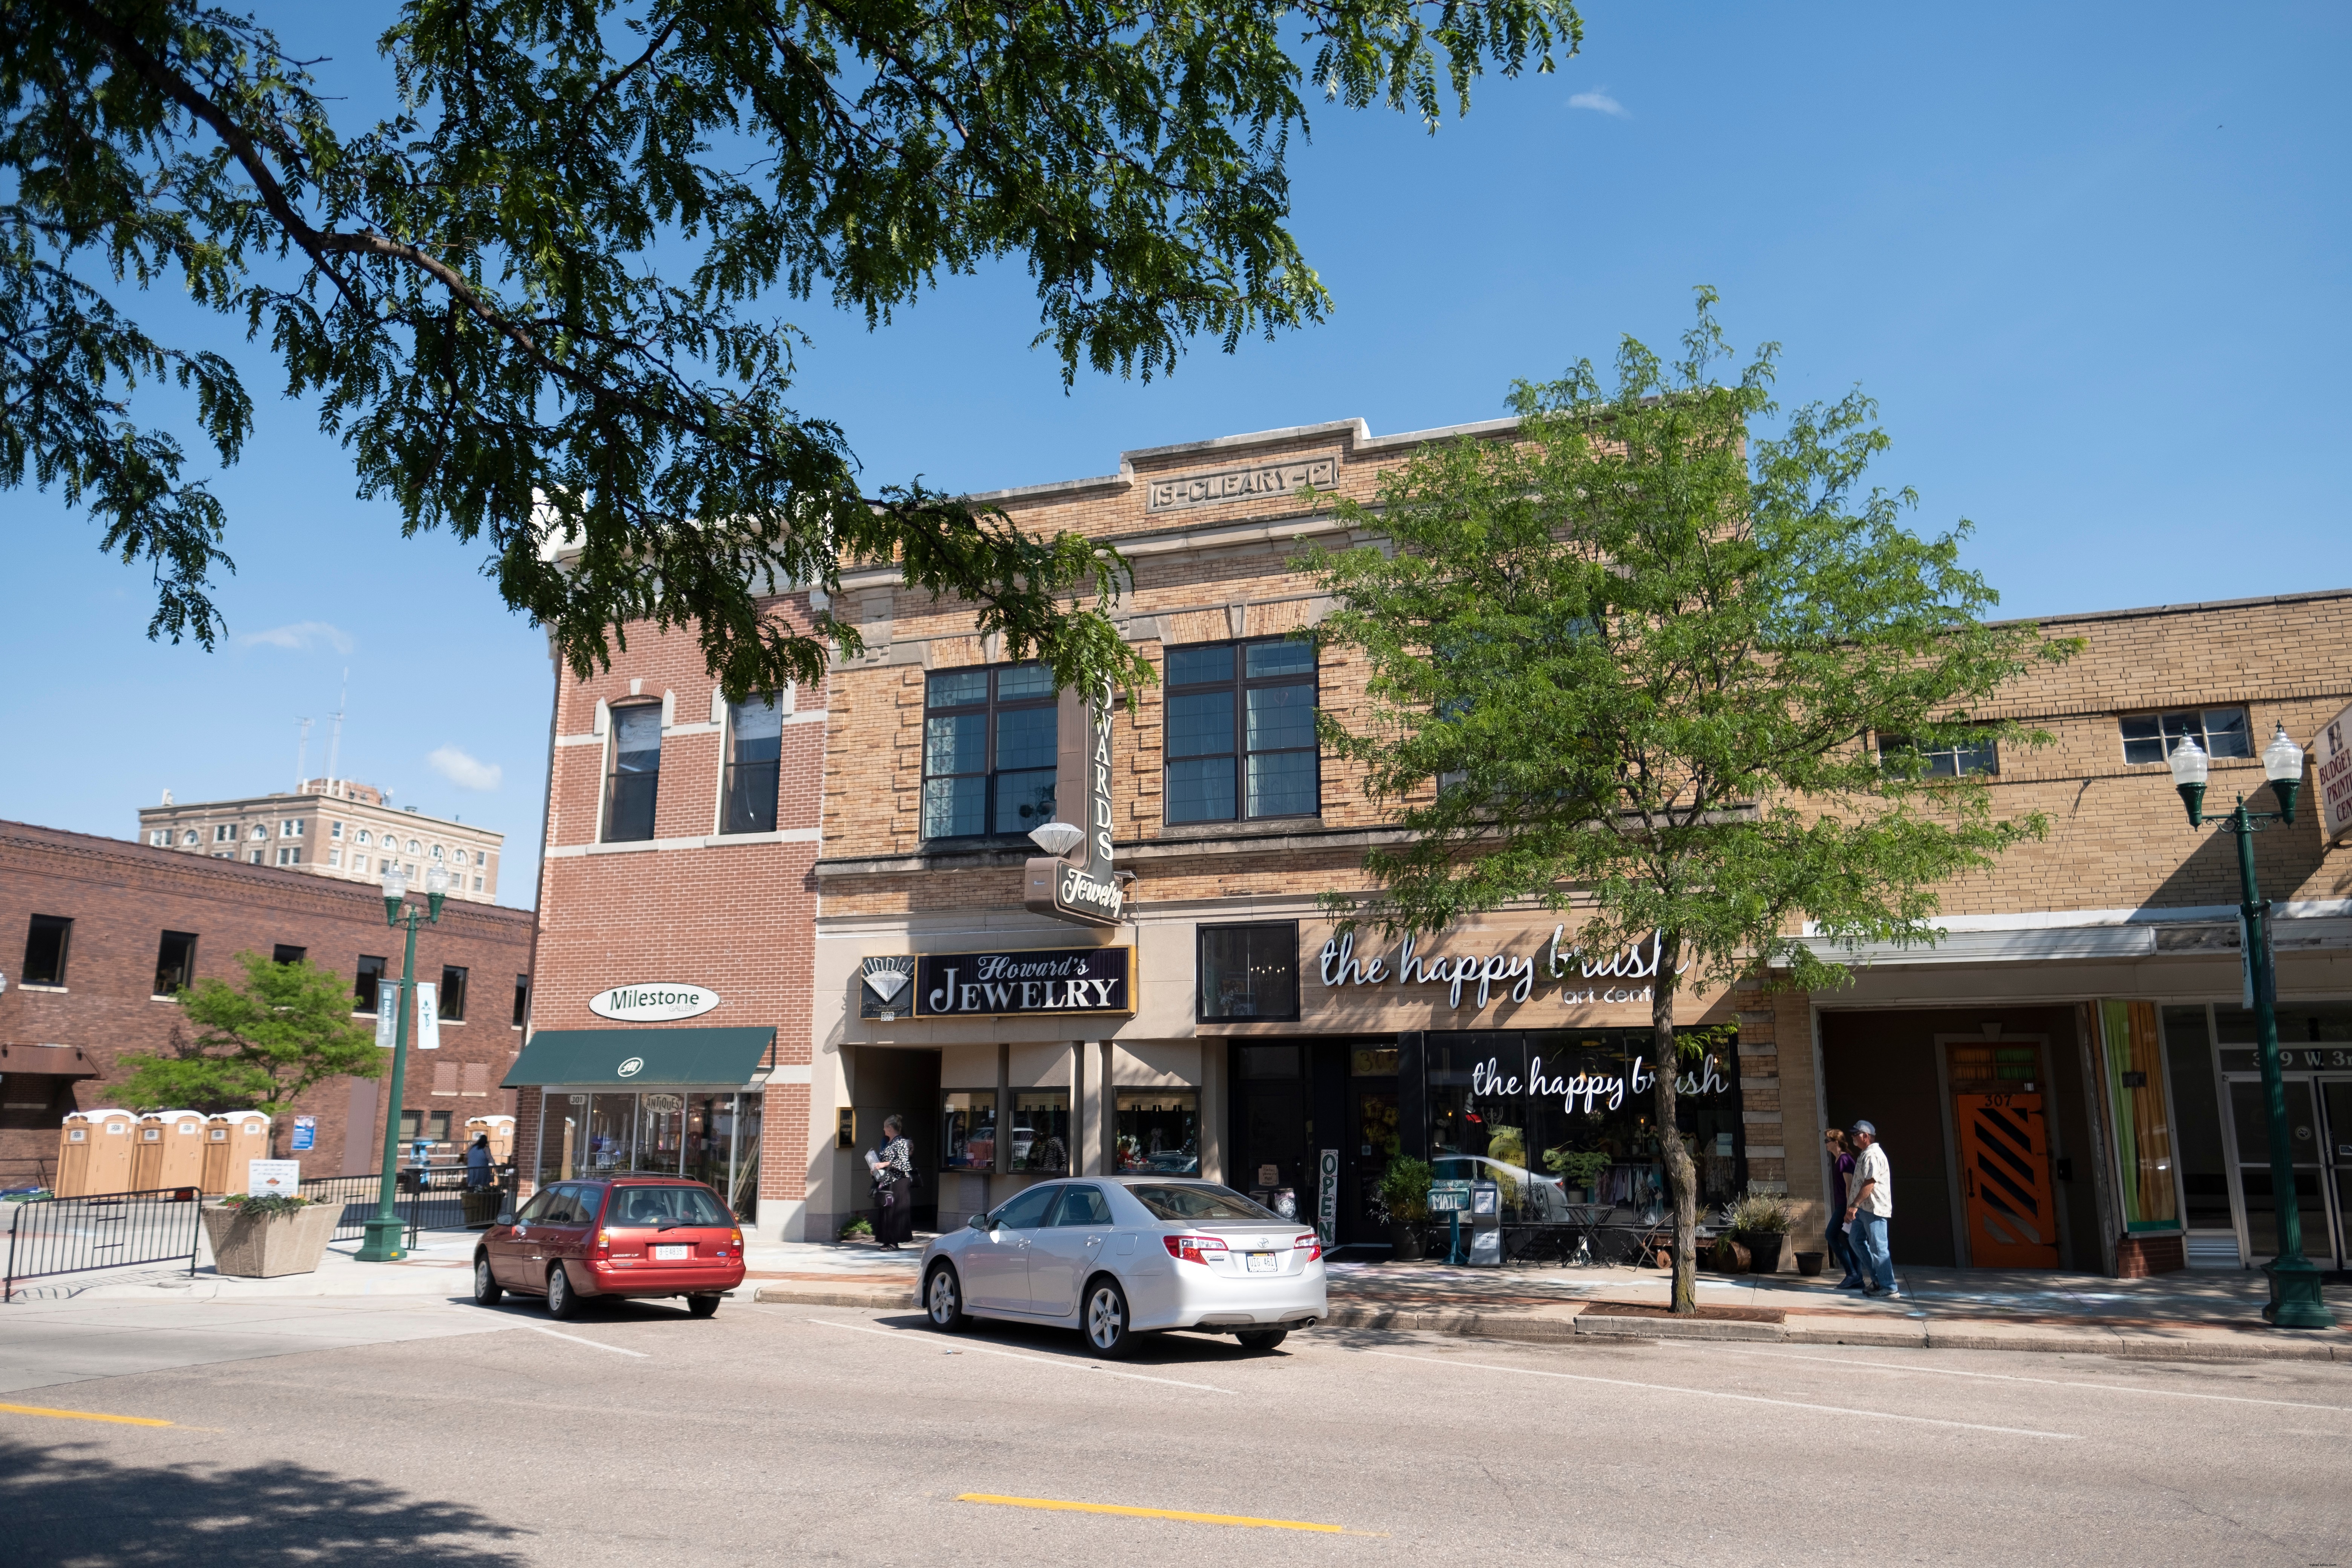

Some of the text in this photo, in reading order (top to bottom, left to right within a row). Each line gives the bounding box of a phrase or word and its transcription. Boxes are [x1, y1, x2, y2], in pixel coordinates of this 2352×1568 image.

[1093, 666, 1114, 861] OWARD'S
[2319, 748, 2351, 786] BUDGET
[1062, 868, 1123, 918] Jewelry
[978, 956, 1089, 980] Howard's
[1319, 931, 1392, 986] the
[1400, 928, 1534, 1009] happy
[609, 990, 699, 1011] Milestone
[929, 968, 1118, 1012] JEWELRY
[1564, 985, 1655, 1005] art cent
[2252, 1051, 2292, 1066] 39
[2303, 1051, 2324, 1066] W.
[1473, 1057, 1522, 1096] the
[1529, 1056, 1623, 1114] happy
[646, 1096, 679, 1110] ANTIQUES
[1985, 1094, 2012, 1107] 307
[1498, 1152, 1520, 1161] Hours
[1319, 1154, 1336, 1242] OPEN
[1430, 1193, 1462, 1210] MAIL
